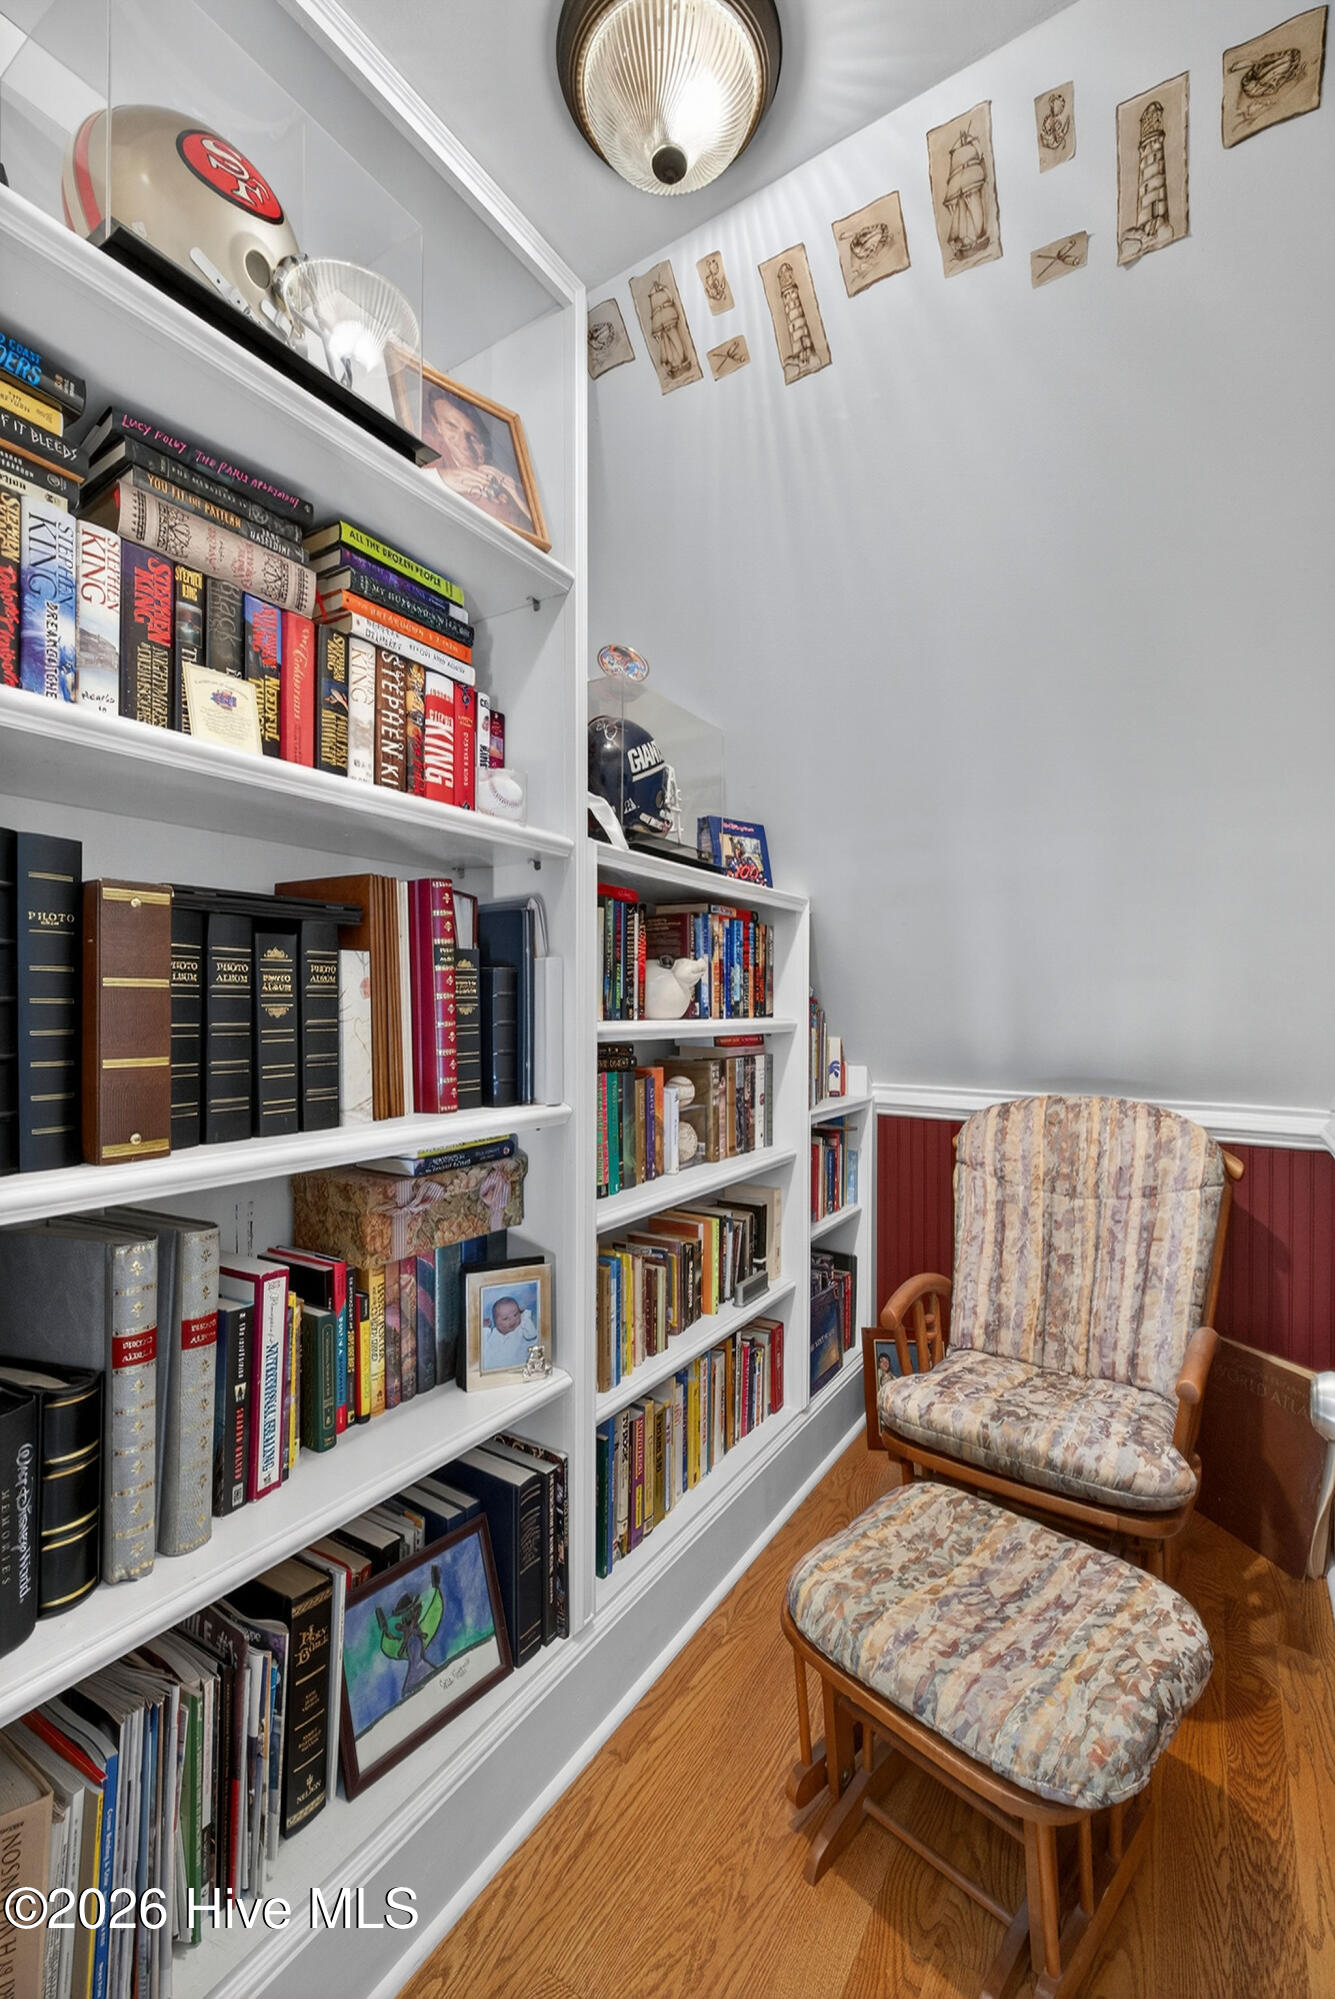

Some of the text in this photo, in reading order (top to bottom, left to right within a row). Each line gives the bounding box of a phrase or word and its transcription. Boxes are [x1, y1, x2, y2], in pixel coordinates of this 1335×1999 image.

[13, 420, 26, 436] IT
[31, 431, 78, 461] BLEEDS
[147, 474, 169, 494] YOU
[28, 512, 57, 600] KING
[58, 522, 74, 609] STEPHEN
[80, 528, 106, 605] KING
[106, 537, 120, 613] STEPHEN
[349, 529, 365, 544] ALL
[365, 535, 380, 553] THE
[410, 560, 442, 588] PEOPLE
[134, 566, 154, 630] KING
[147, 556, 171, 648] STEPHEN
[218, 582, 242, 647] Black
[45, 600, 61, 699] DREAMCATCHE
[351, 647, 368, 704] KING
[265, 675, 280, 742] NEEDFUL
[381, 650, 399, 786] STEPHEN KI
[424, 720, 454, 788] KING
[28, 911, 75, 923] PHOTO
[172, 972, 198, 982] LBUM
[215, 973, 248, 983] ALBUM
[216, 962, 249, 971] PHOTO
[262, 973, 291, 983] PHOTO
[262, 983, 292, 992] ALBUM
[310, 964, 337, 974] PHOTO
[310, 974, 337, 983] ALBUM
[1270, 1390, 1311, 1420] ATLA
[0, 1488, 11, 1586] MEMORIES
[294, 1636, 329, 1667] BIBLE
[299, 1623, 329, 1647] HOLY
